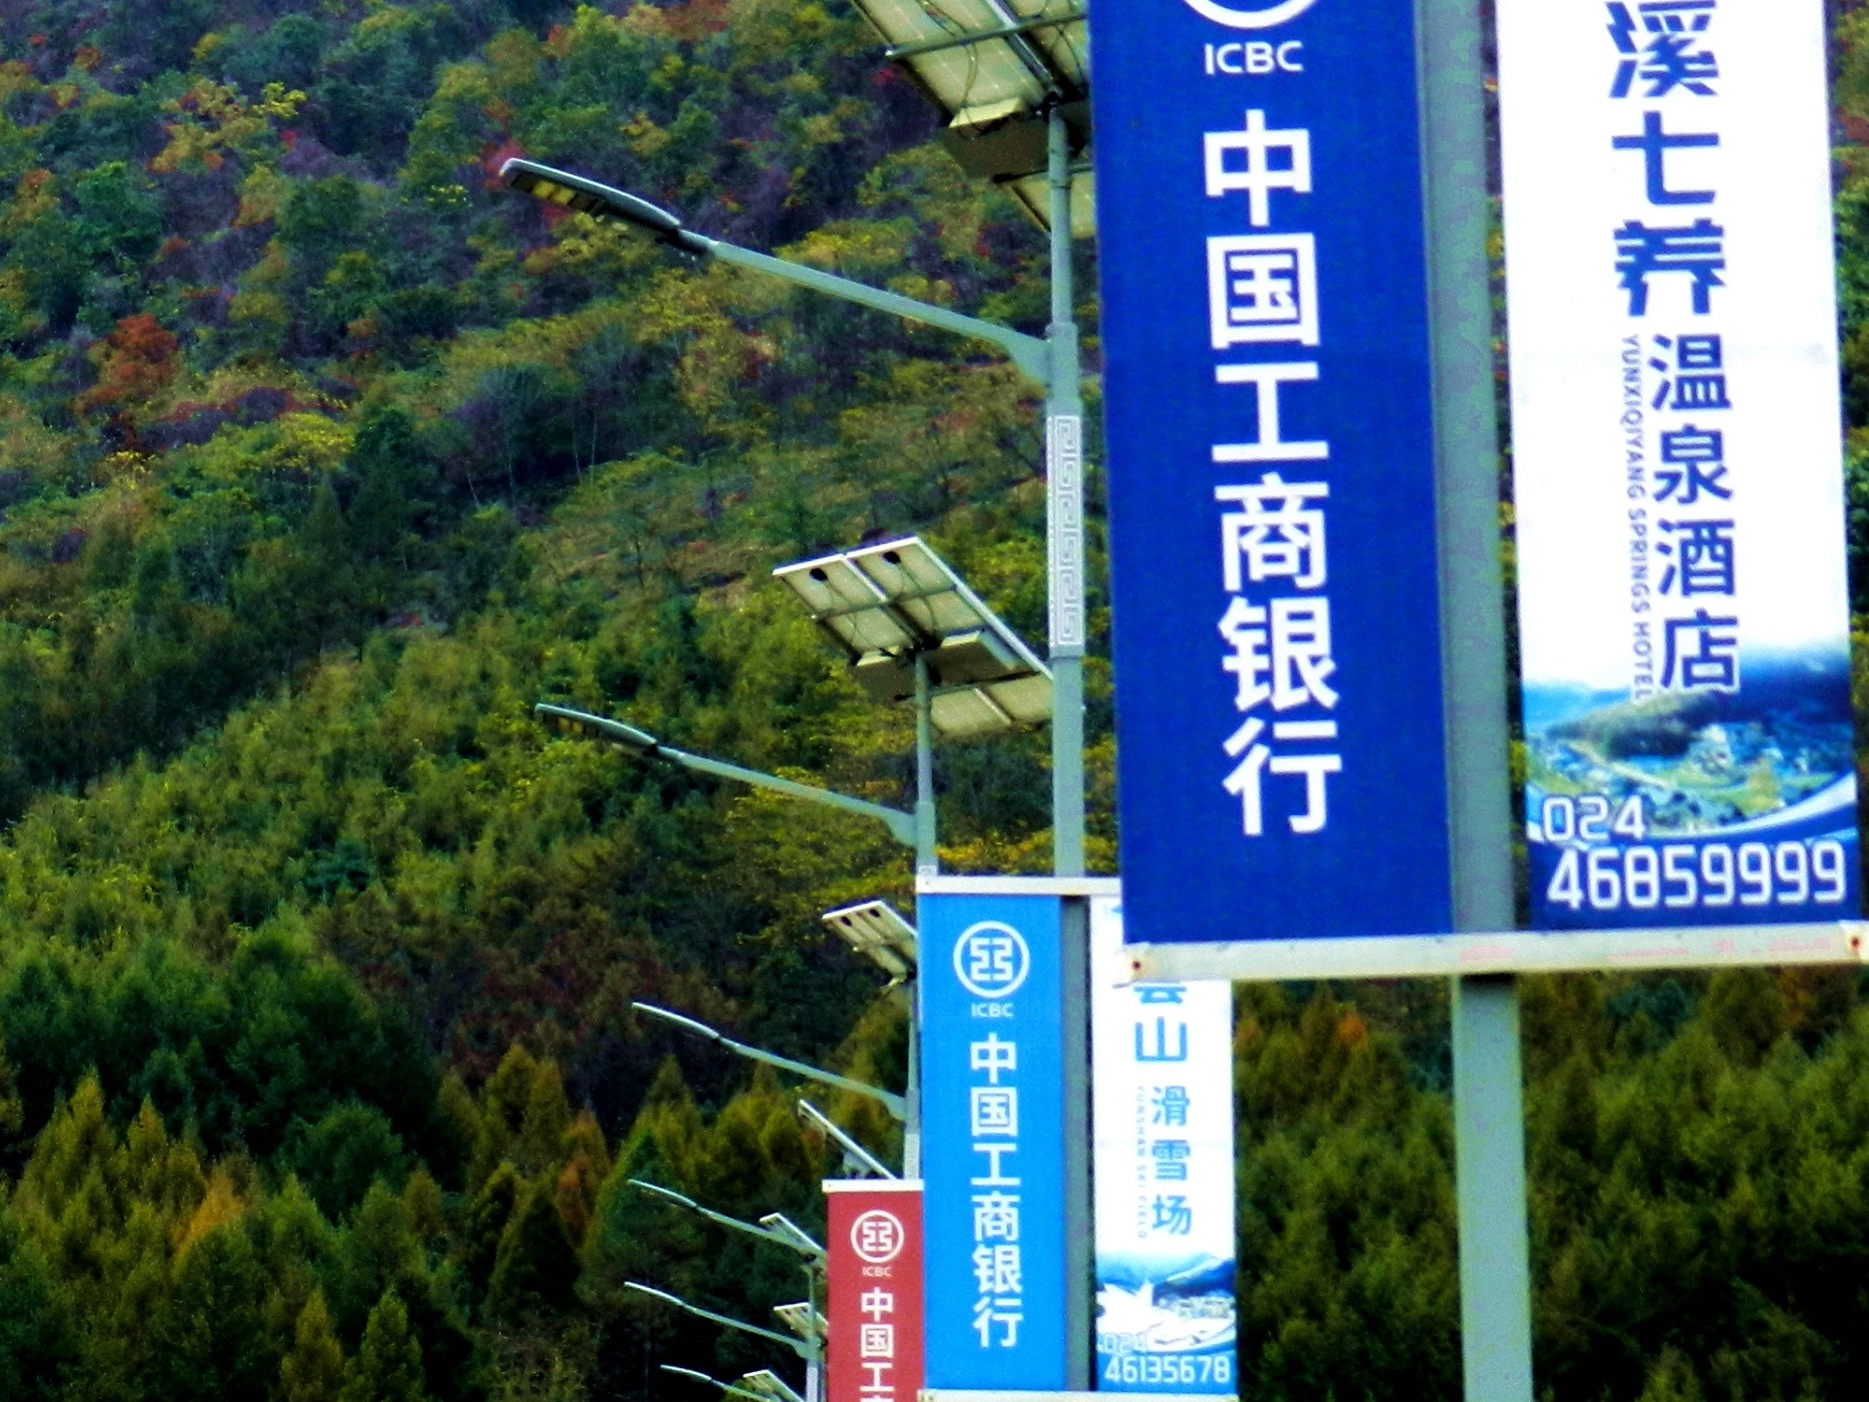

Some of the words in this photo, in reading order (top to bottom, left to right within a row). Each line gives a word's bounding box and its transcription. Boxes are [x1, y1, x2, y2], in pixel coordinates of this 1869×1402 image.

[1205, 40, 1304, 75] ICBC
[1620, 334, 1646, 500] YUNXIQIYANG
[1204, 109, 1342, 836] 中国工商银行
[1628, 508, 1651, 613] SPRINGS
[1633, 622, 1655, 700] HOTEL
[1543, 796, 1646, 841] 024
[1547, 841, 1846, 910] 46859999
[971, 1003, 1014, 1018] ICBC
[970, 1032, 1023, 1347] 中国工商银行
[862, 1266, 892, 1277] ICBC
[1104, 1355, 1230, 1384] 46135678
